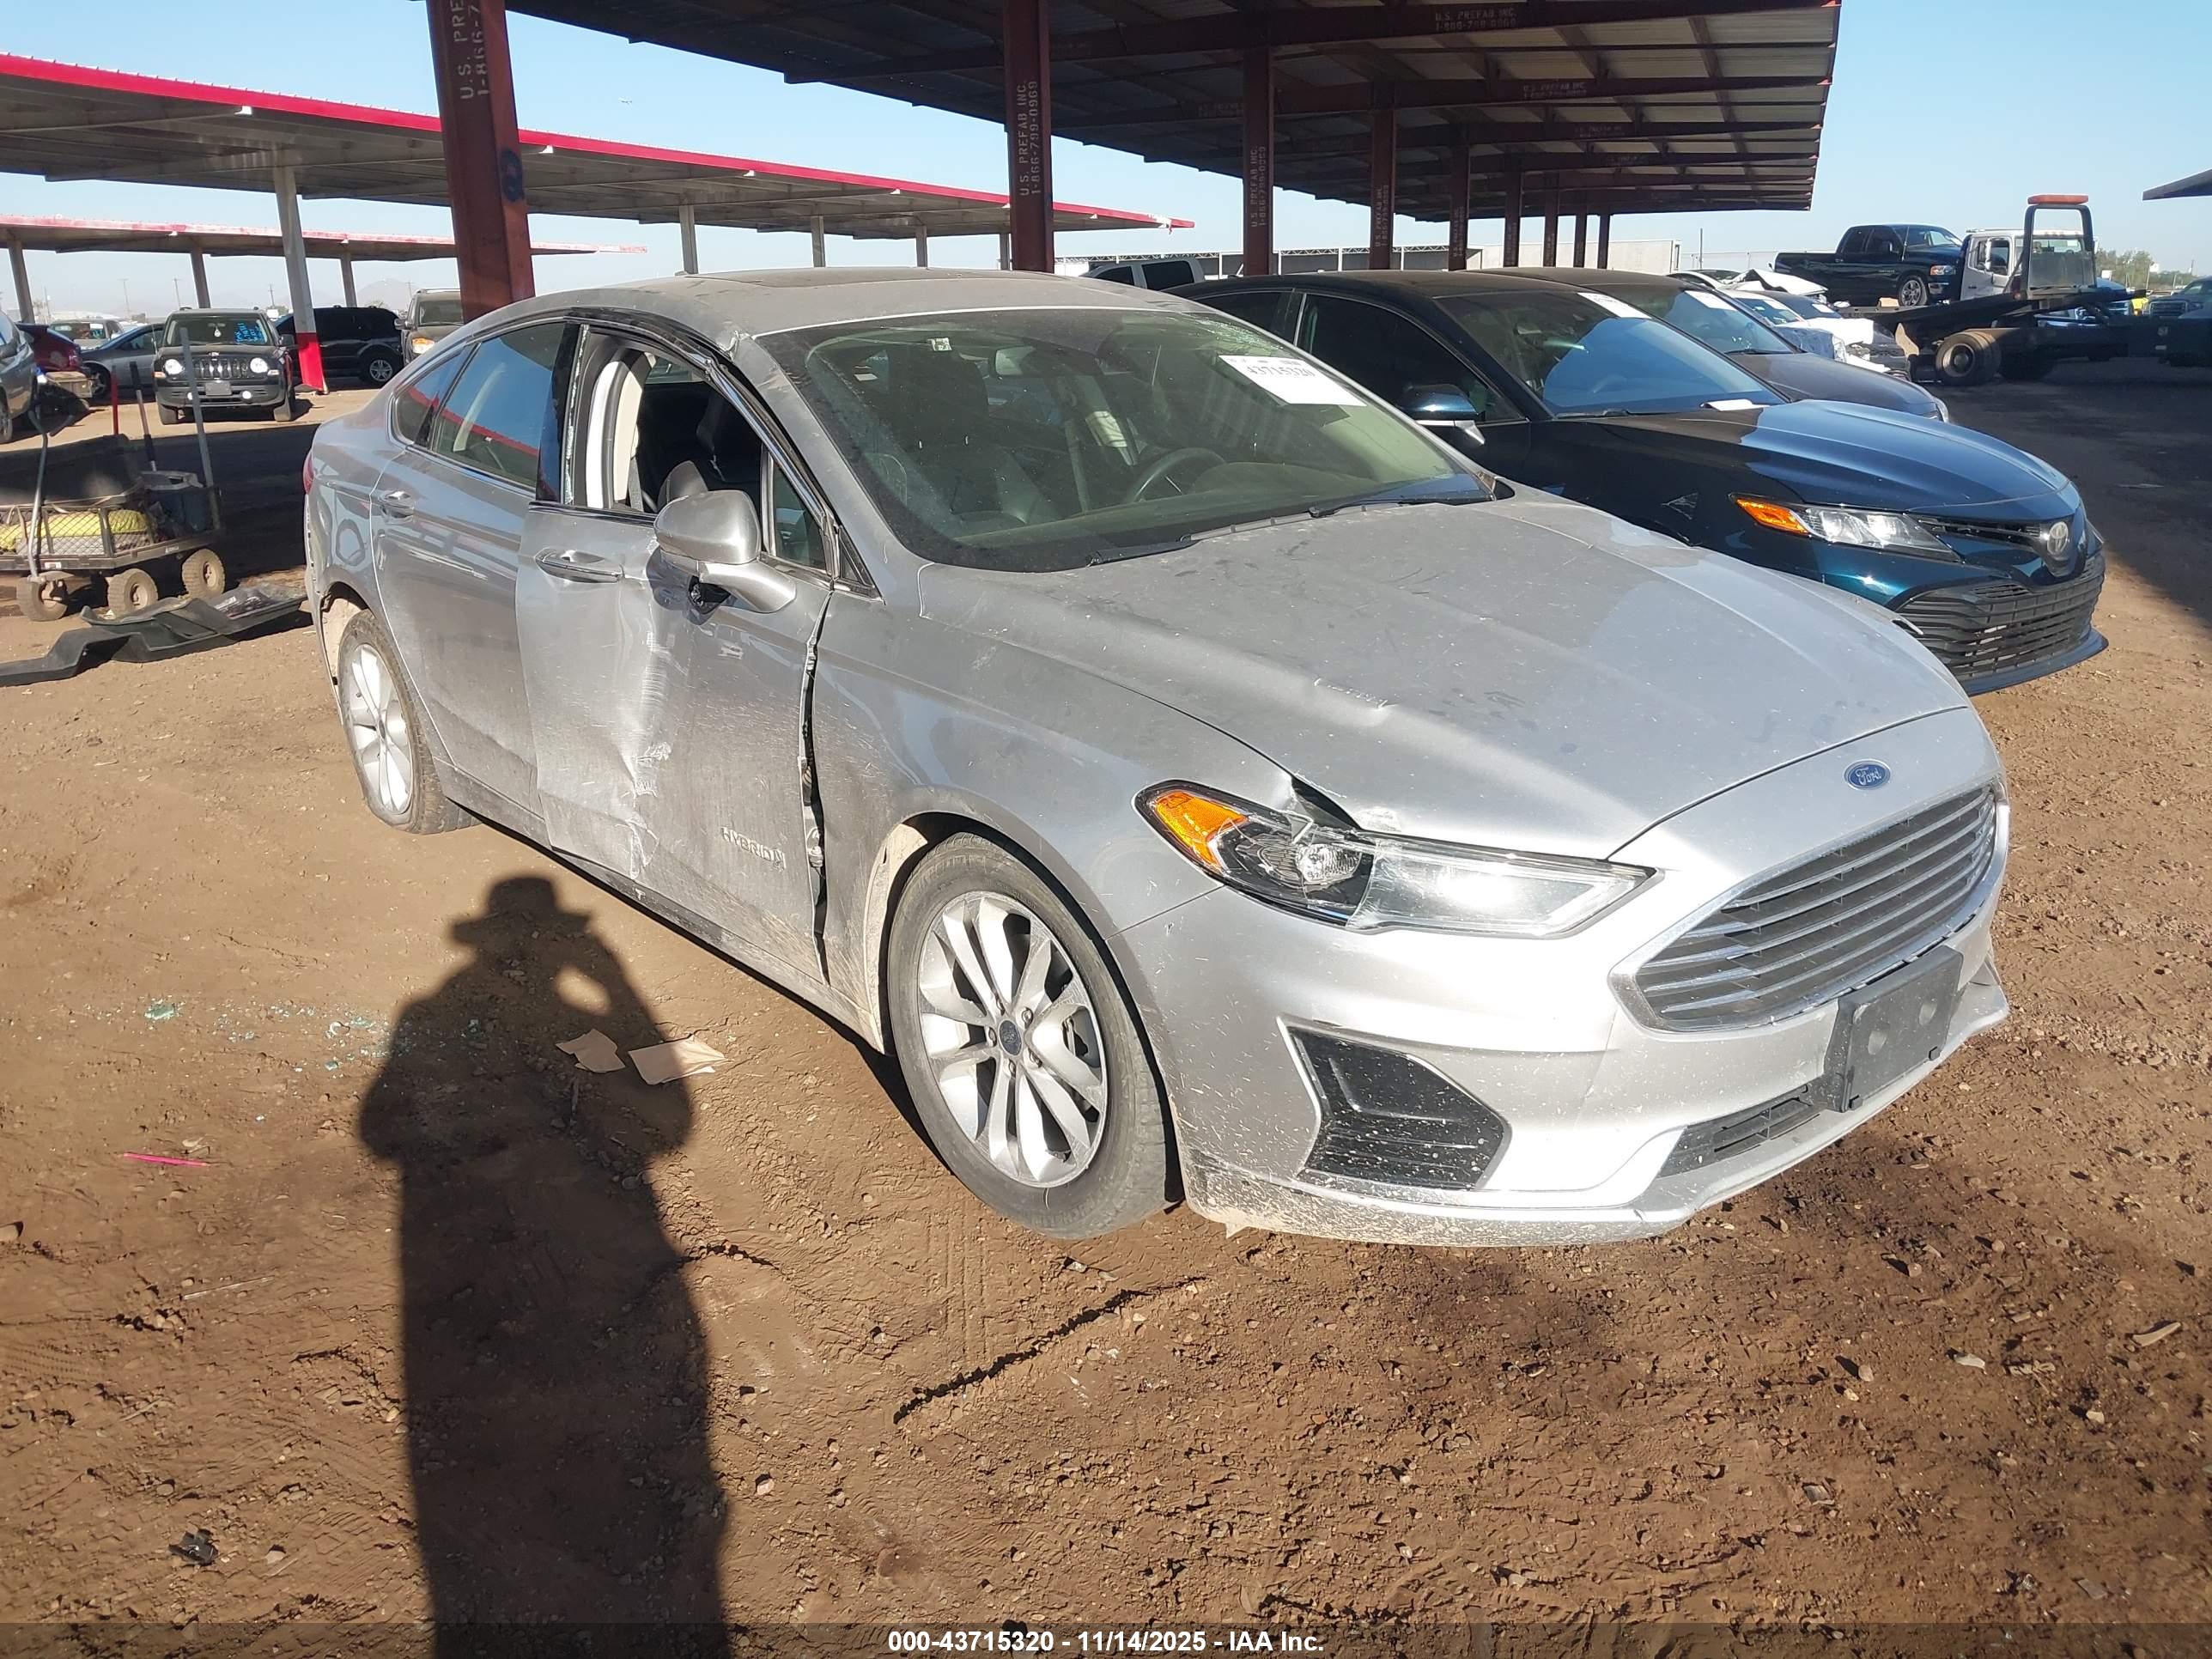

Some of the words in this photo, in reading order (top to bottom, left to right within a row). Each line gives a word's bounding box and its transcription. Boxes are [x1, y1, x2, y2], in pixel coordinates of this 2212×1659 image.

[457, 57, 474, 100] U.S.
[1017, 81, 1028, 106] INC.
[1017, 112, 1030, 164] PREFAB
[1028, 81, 1042, 196] 1-866-799-0969
[1019, 171, 1030, 197] U.S.
[1855, 767, 1882, 786] Ford
[721, 826, 775, 862] HYBRID
